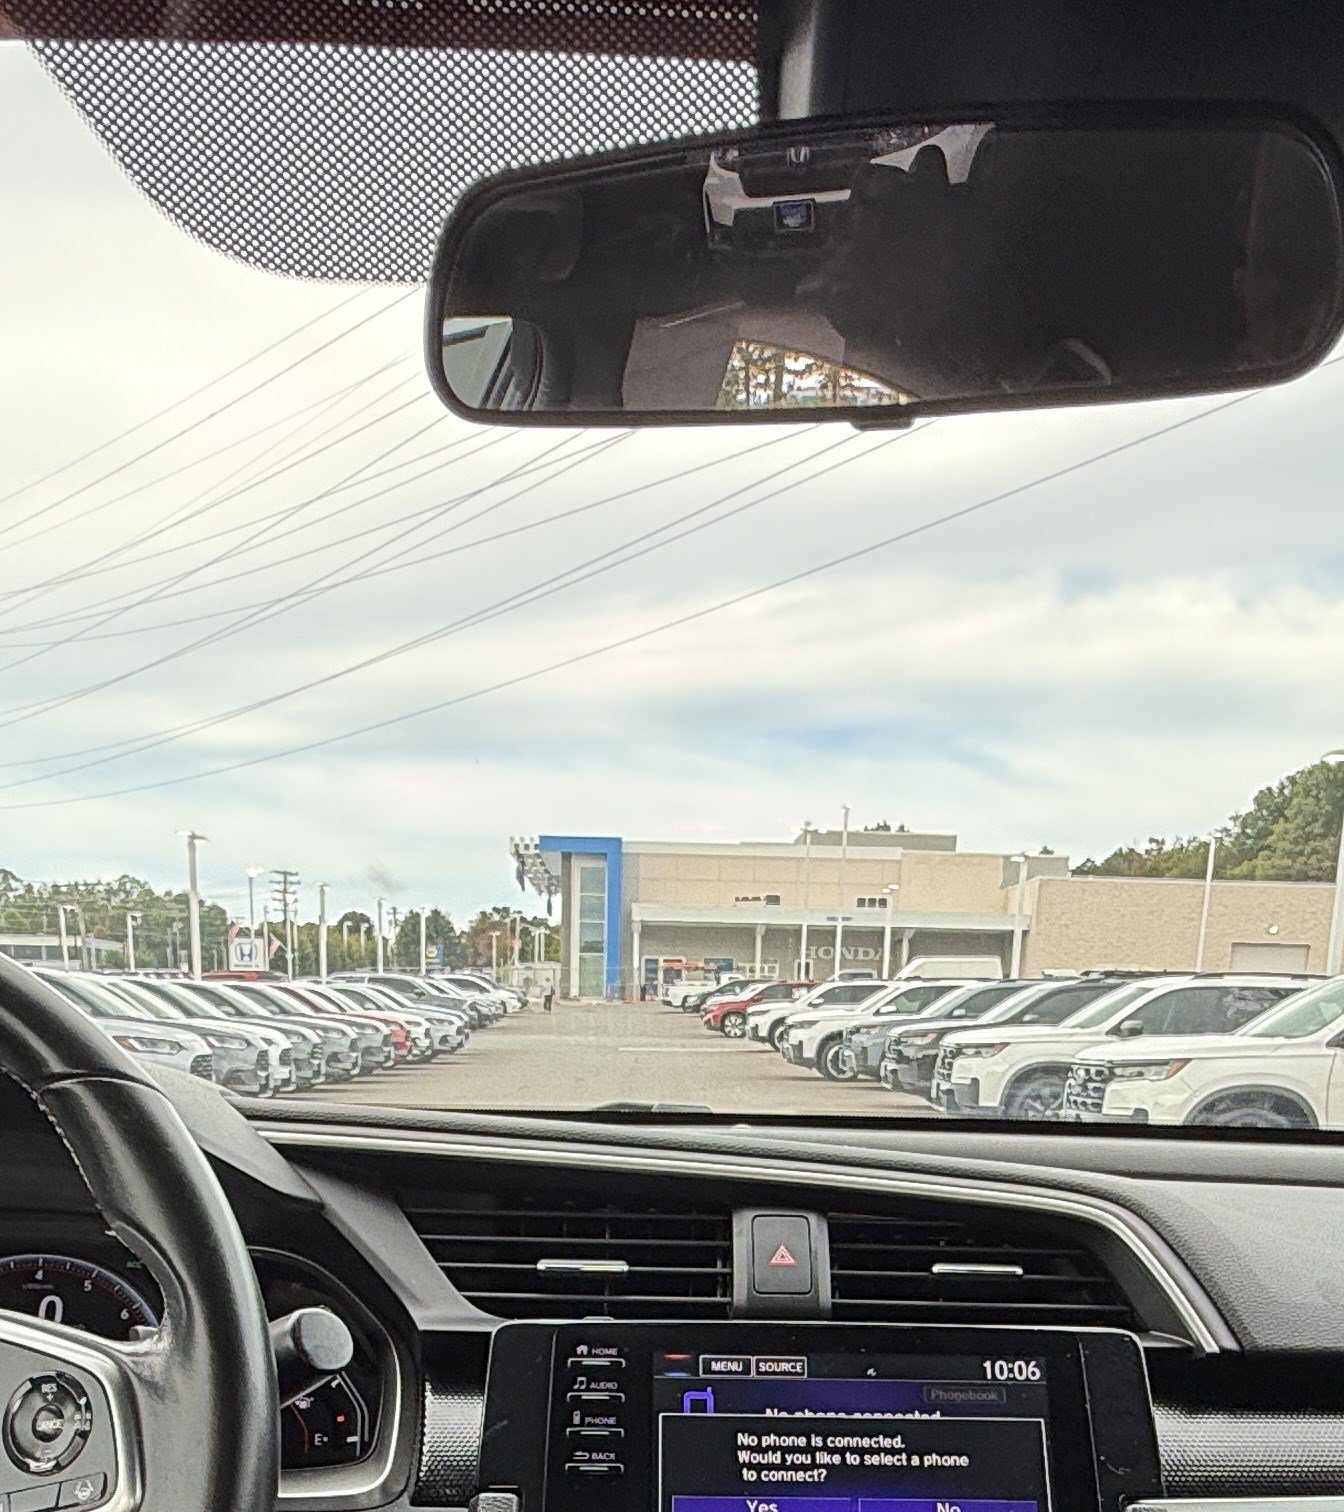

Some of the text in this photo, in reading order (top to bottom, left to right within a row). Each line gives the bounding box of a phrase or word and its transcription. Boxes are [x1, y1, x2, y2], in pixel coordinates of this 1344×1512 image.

[35, 1269, 44, 1280] 4
[83, 1279, 93, 1292] 5
[38, 1295, 64, 1323] 0
[120, 1308, 130, 1320] 6
[591, 1348, 619, 1356] HOME
[711, 1360, 1042, 1381] MENU SOURCE 10:06
[589, 1381, 618, 1390] AUDIO
[584, 1416, 617, 1425] PHONE
[314, 1433, 323, 1446] E
[737, 1432, 906, 1449] No phone is connected.
[591, 1452, 616, 1460] BACK
[737, 1450, 970, 1468] Would you like to select a phone
[742, 1467, 827, 1483] to connect?
